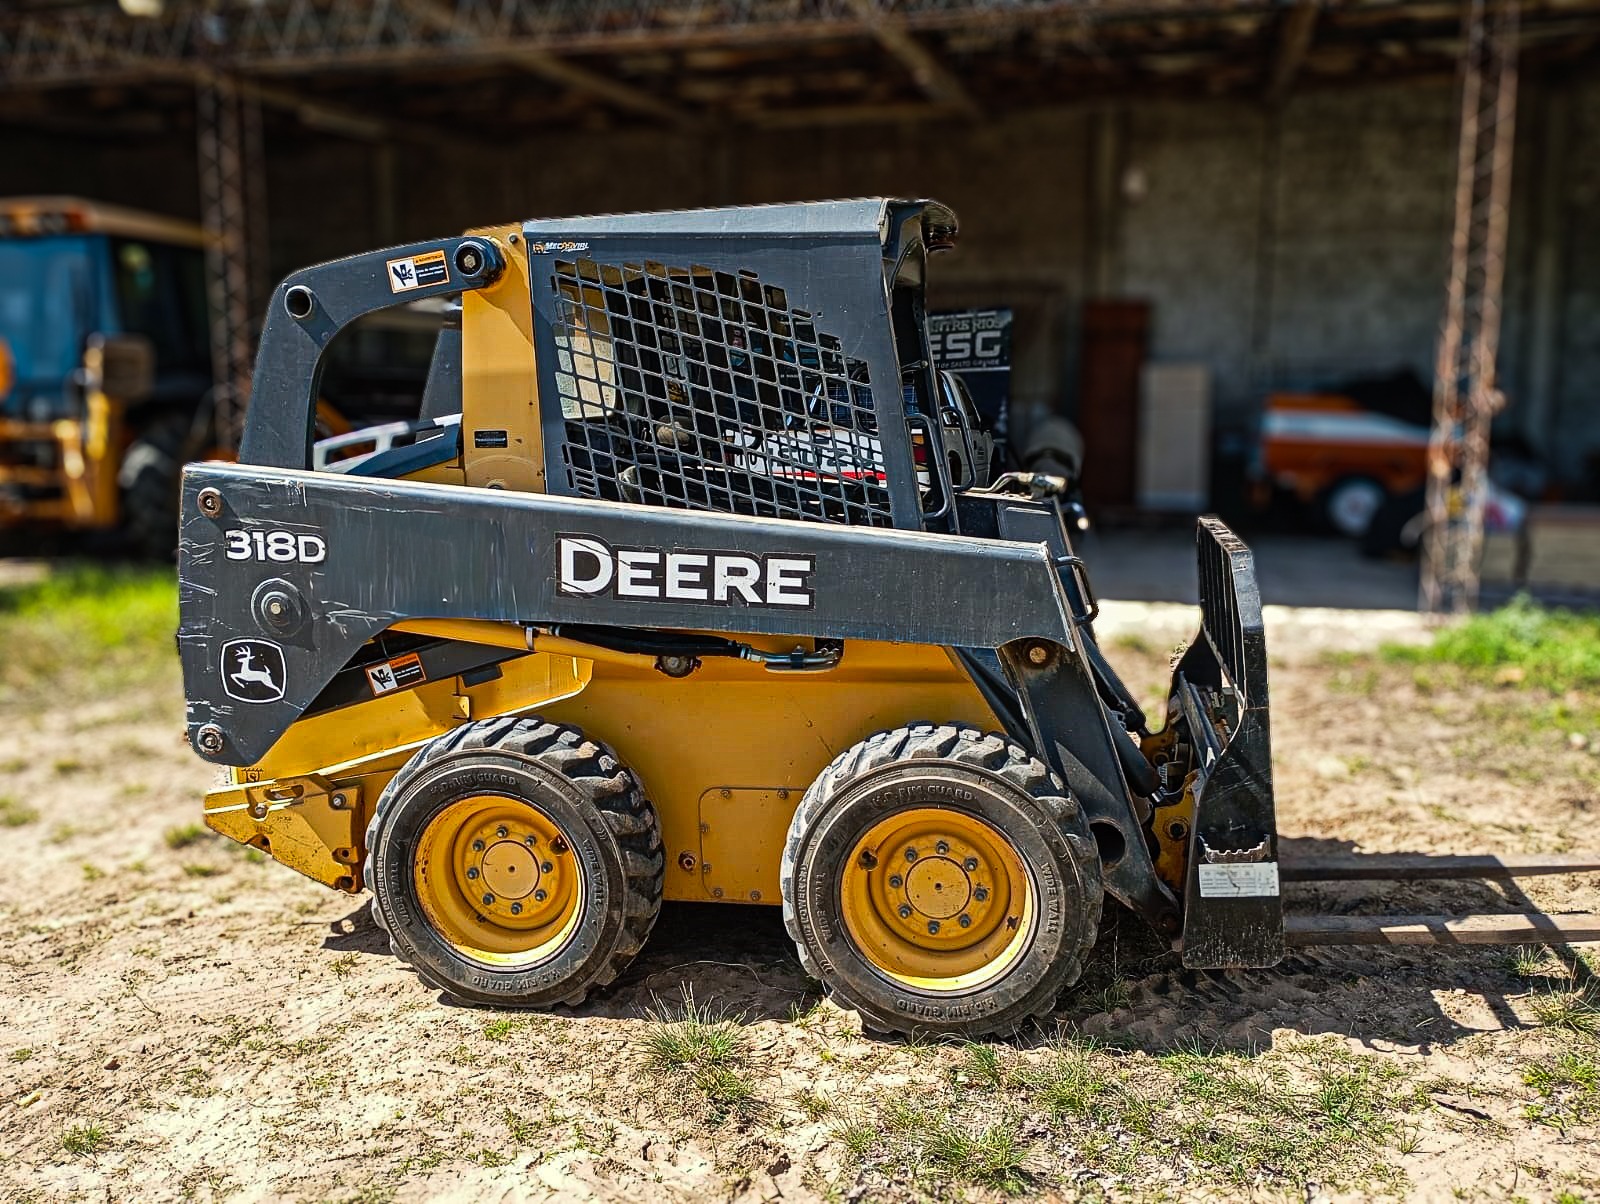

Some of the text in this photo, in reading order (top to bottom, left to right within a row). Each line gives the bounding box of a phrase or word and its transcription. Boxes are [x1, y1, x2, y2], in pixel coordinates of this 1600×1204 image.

[972, 317, 1004, 333] RIOS
[225, 529, 326, 563] 318D
[561, 538, 811, 606] DEERE
[477, 773, 516, 786] GUARD
[927, 785, 974, 801] GUARD
[1041, 862, 1059, 935] WIDE WALL
[471, 975, 513, 990] GUARD
[896, 999, 943, 1018] GUARD
